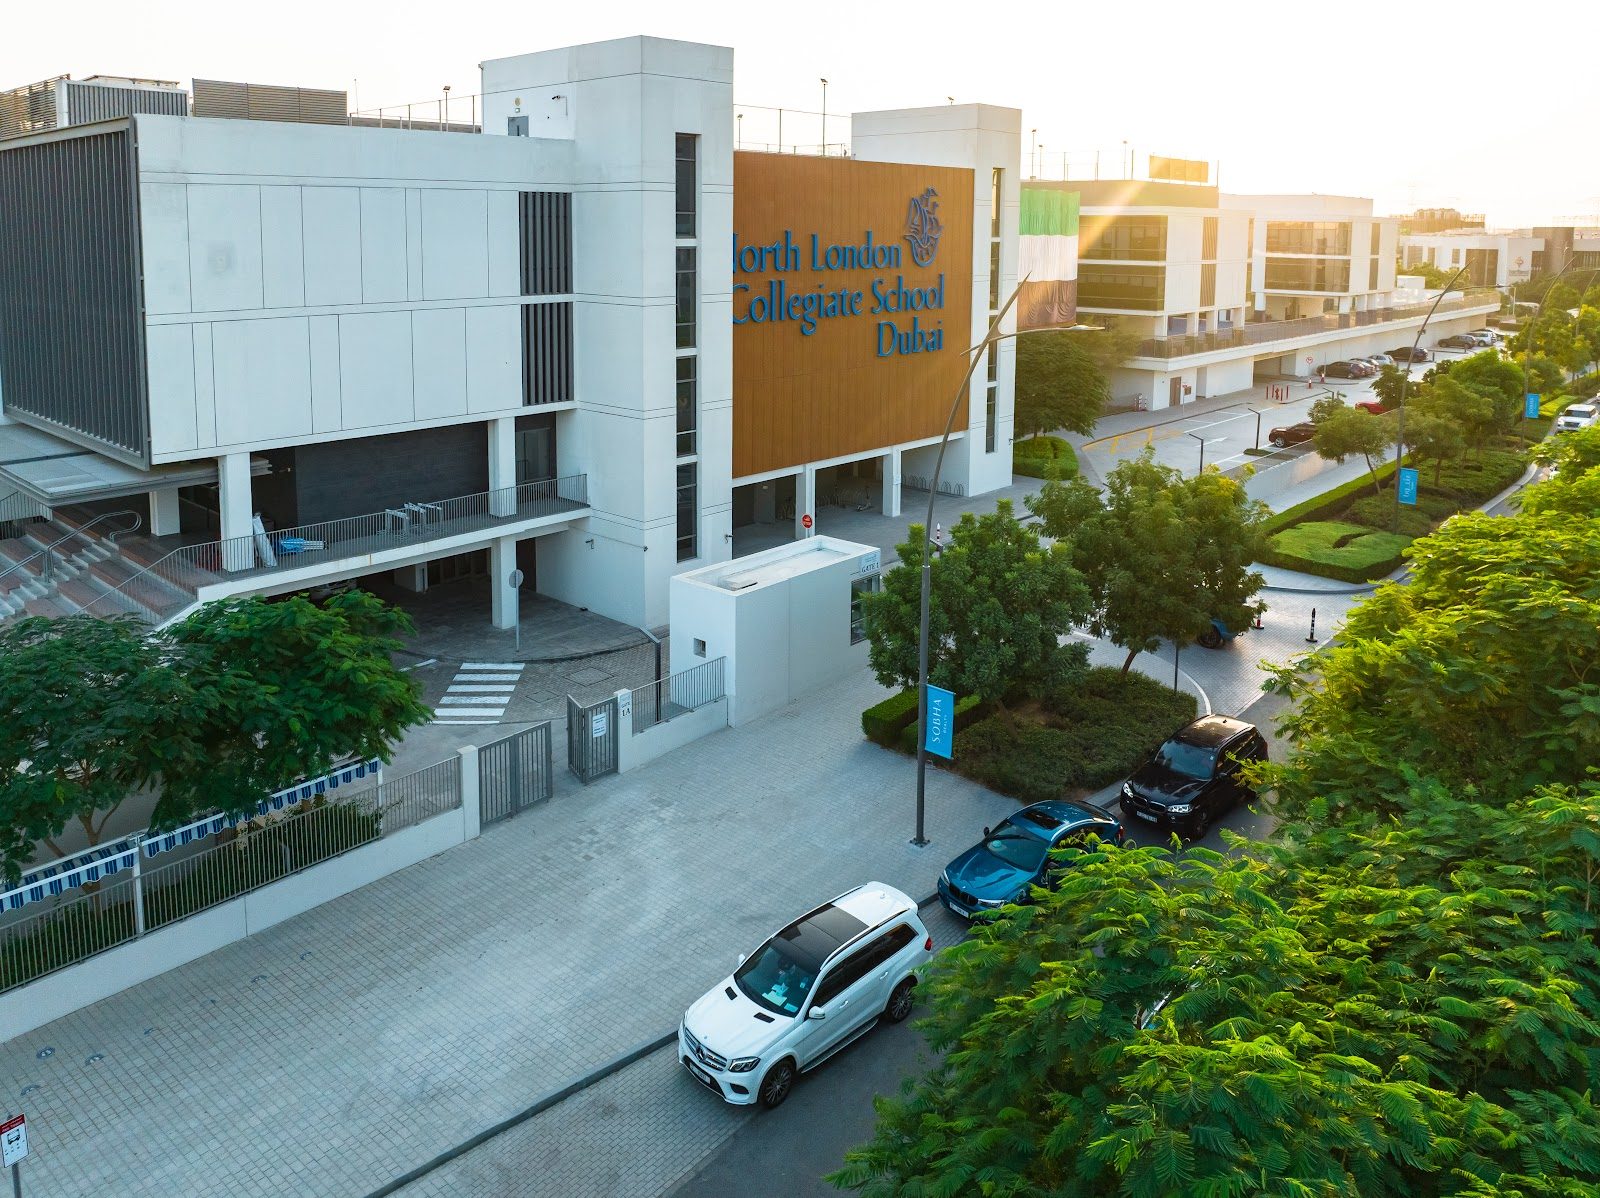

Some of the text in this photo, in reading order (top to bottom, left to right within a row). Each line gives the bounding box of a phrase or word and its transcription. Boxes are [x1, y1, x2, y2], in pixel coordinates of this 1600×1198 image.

[732, 230, 902, 273] orth London
[732, 273, 945, 336] Collegiate School
[877, 316, 944, 357] Dubai
[931, 699, 942, 744] SOBHA
